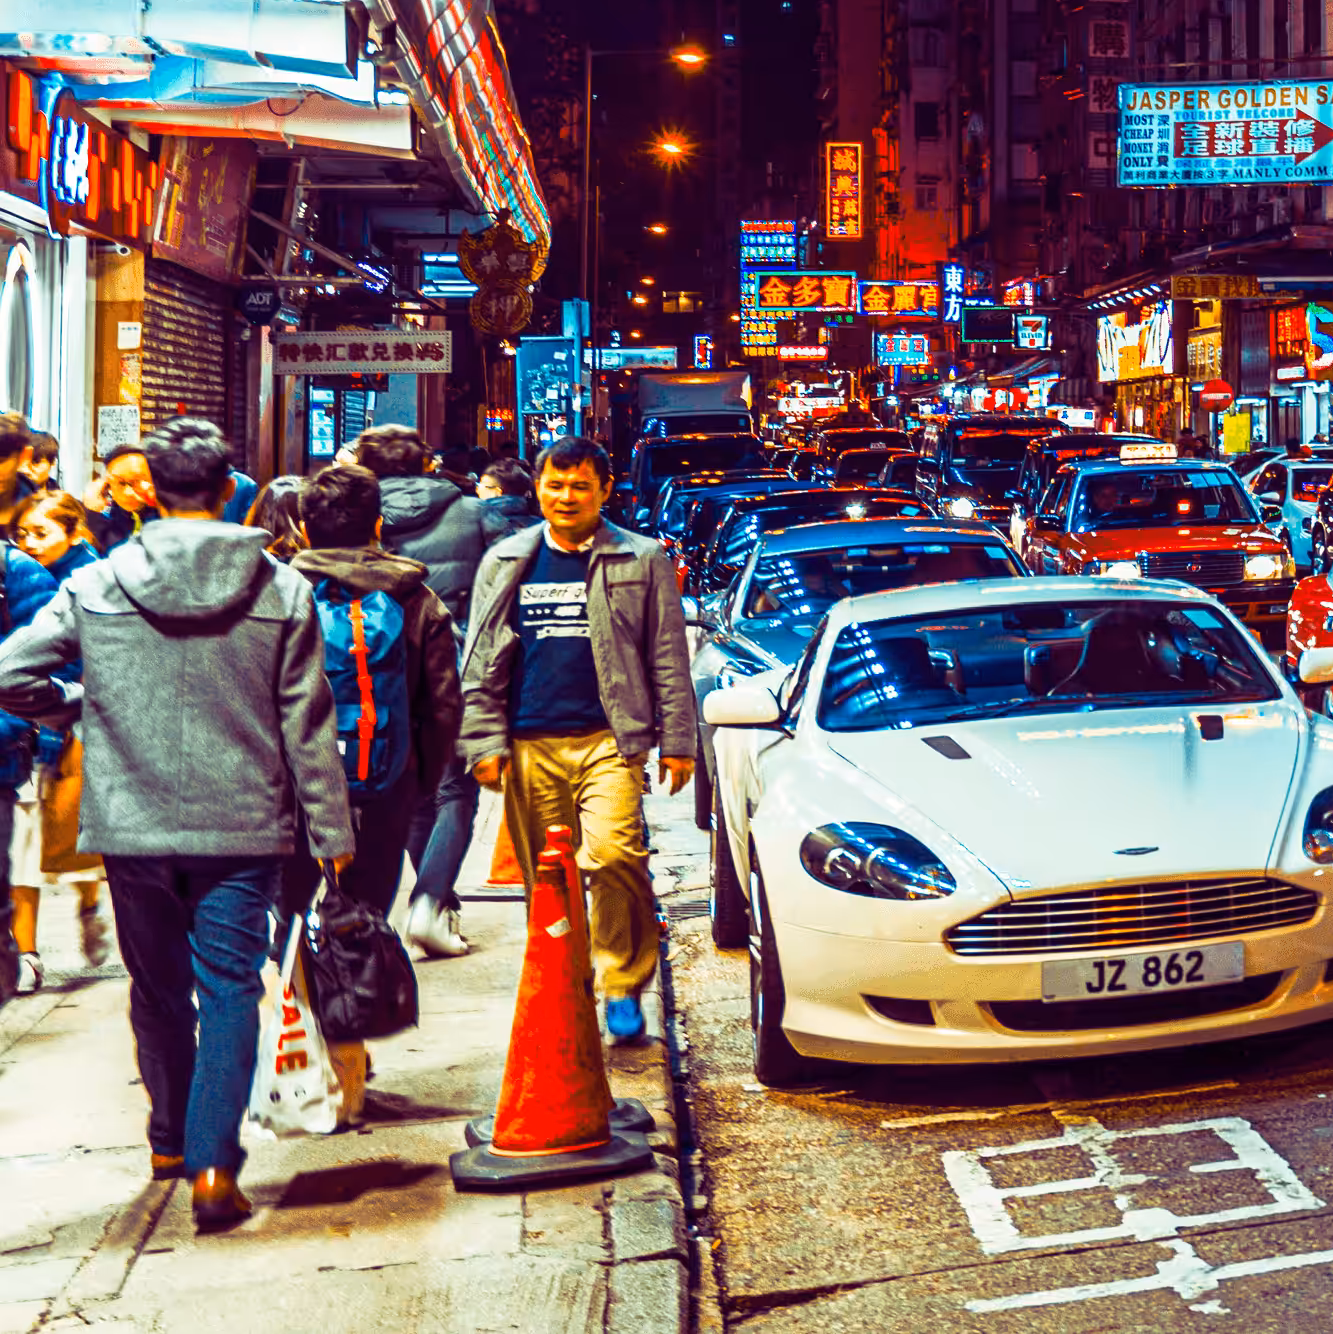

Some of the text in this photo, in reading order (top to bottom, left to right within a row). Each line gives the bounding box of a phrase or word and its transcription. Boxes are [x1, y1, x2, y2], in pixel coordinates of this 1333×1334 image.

[1127, 90, 1211, 112] JASPER
[1217, 86, 1309, 109] GOLDEN
[1124, 114, 1154, 126] MOST
[1174, 110, 1231, 120] TOURIST
[1124, 128, 1154, 139] CHEAP
[1181, 119, 1316, 140] 全新裝修
[1124, 142, 1153, 154] MONEY
[1124, 156, 1153, 167] ONLY
[1233, 167, 1280, 179] MANLY
[1285, 165, 1328, 177] COMM
[246, 291, 273, 306] ADT
[944, 265, 964, 322] 東方
[1086, 951, 1205, 993] JZ 862
